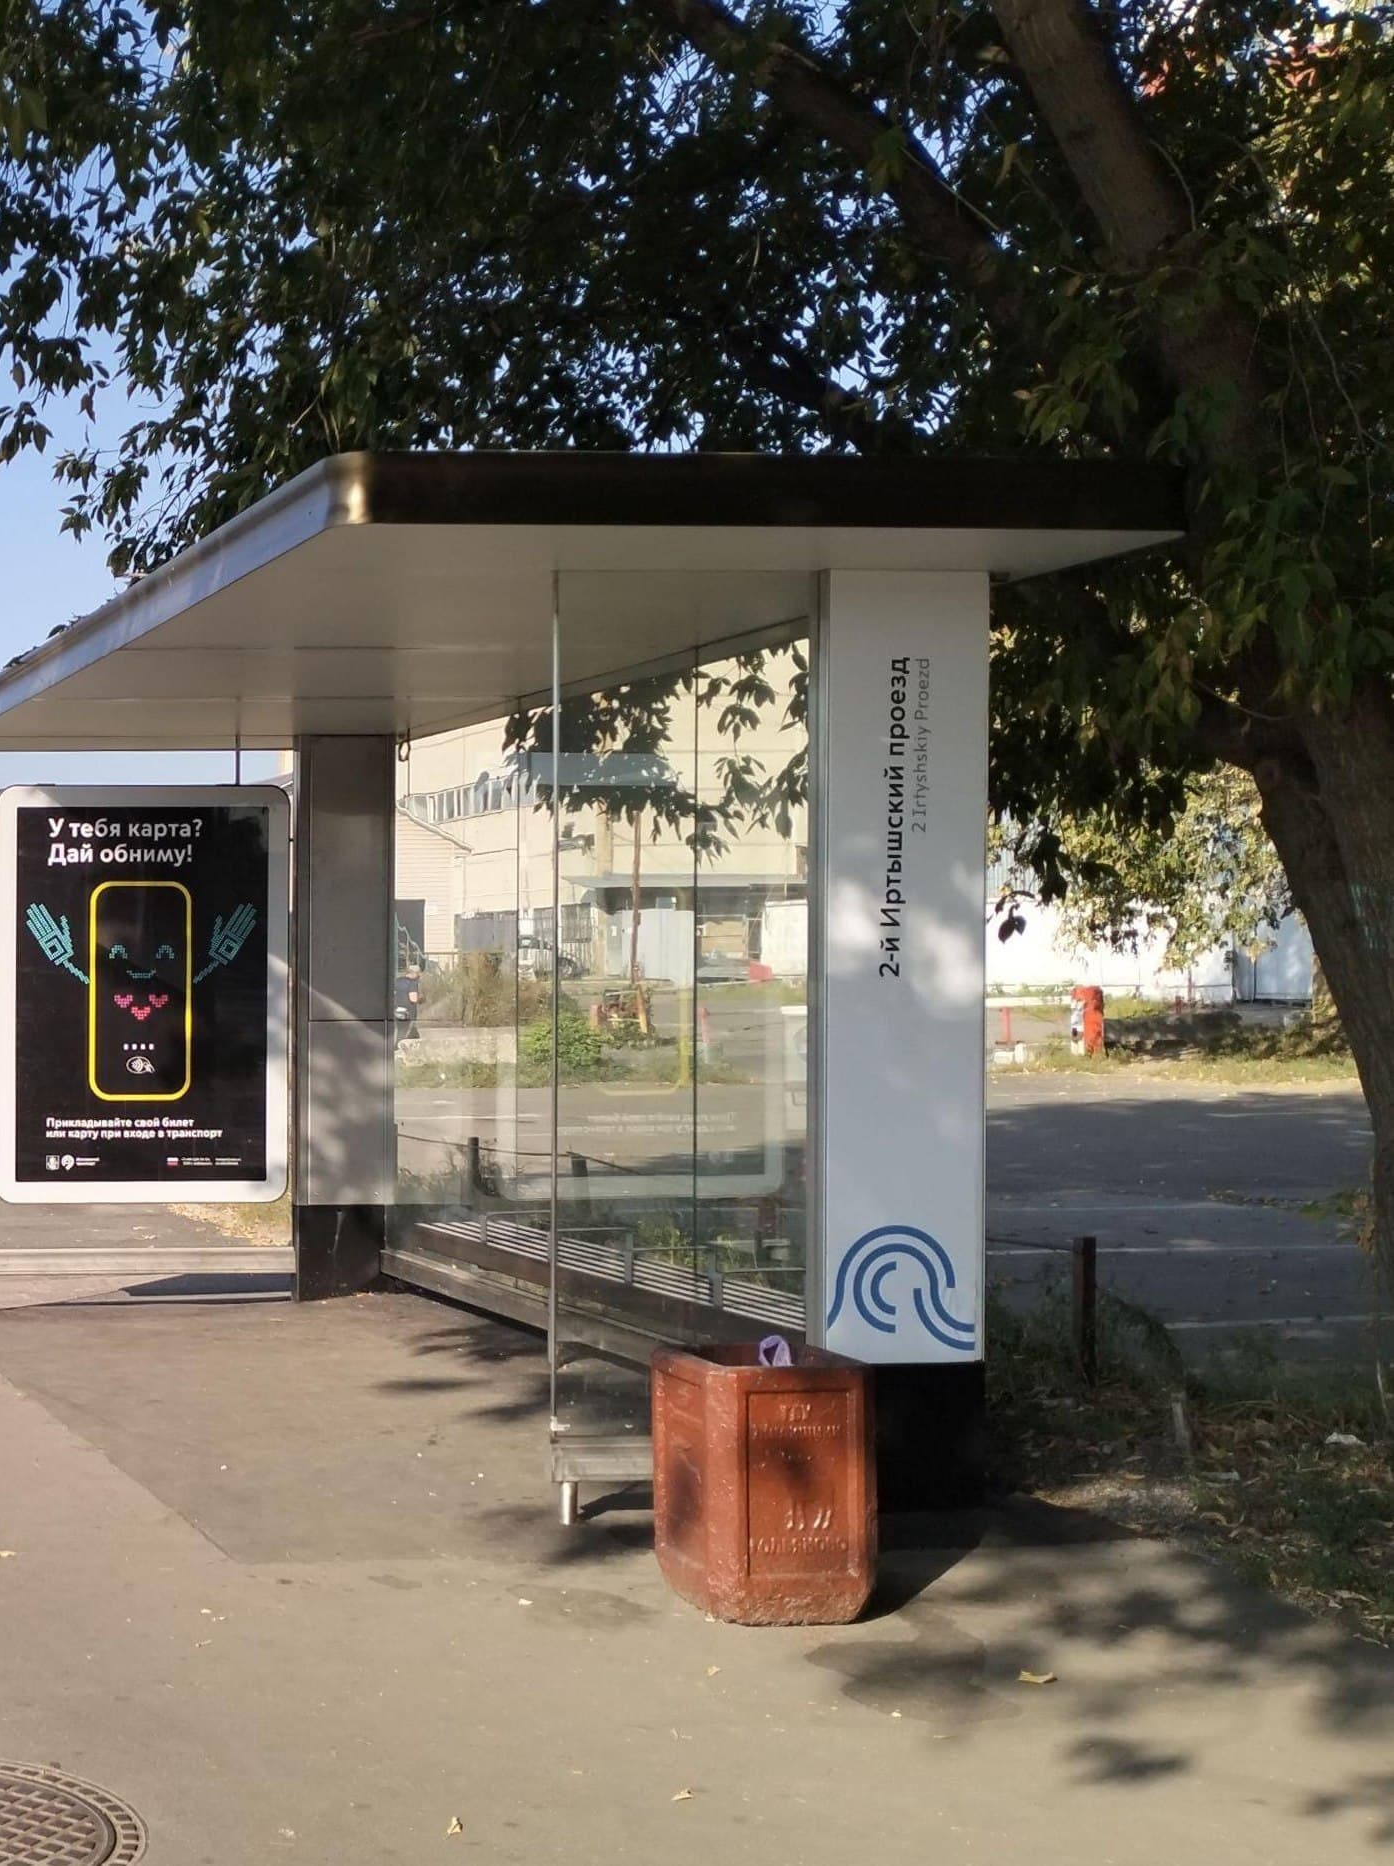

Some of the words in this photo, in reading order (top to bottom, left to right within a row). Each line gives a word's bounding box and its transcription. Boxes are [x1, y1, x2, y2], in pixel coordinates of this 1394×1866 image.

[915, 658, 930, 720] Proezd
[888, 657, 910, 756] проезд
[912, 725, 932, 817] Irtyshskiy
[48, 817, 65, 838] У
[69, 818, 121, 838] тебя
[128, 818, 203, 841] карта?
[912, 821, 926, 833] 2
[47, 843, 94, 866] Дай
[100, 843, 193, 867] обниму!
[880, 766, 906, 928] Иртышский
[880, 938, 900, 978] 2-й
[46, 1117, 132, 1129] Прикладывайте
[134, 1117, 160, 1127] свой
[162, 1117, 194, 1127] билет
[46, 1130, 66, 1138] или
[68, 1130, 99, 1139] карту
[100, 1130, 121, 1139] при
[123, 1129, 156, 1139] входе
[166, 1129, 223, 1139] транспорт
